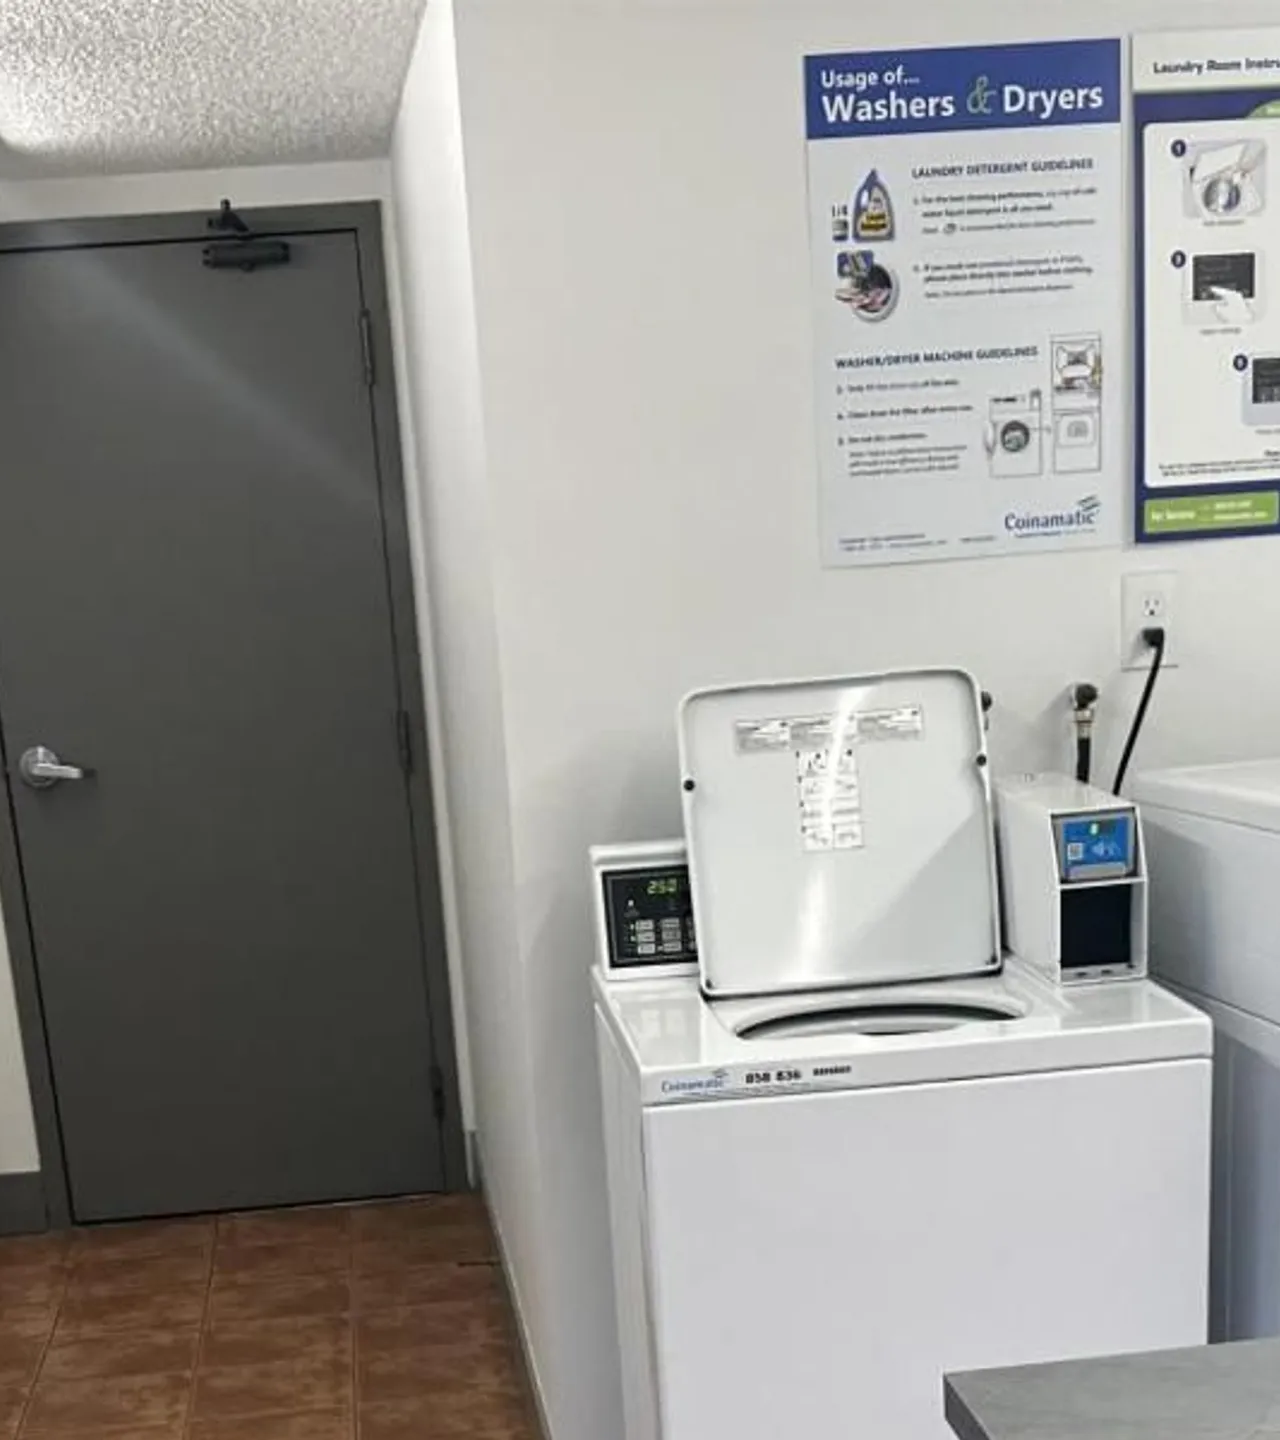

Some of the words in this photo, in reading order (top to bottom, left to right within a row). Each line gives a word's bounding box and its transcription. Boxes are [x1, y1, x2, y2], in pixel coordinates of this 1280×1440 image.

[1153, 60, 1203, 76] Laundry
[1207, 58, 1241, 72] Room
[821, 69, 878, 92] Usage
[822, 92, 955, 123] Washers
[966, 76, 997, 114] &
[1003, 85, 1103, 119] Dryers
[912, 165, 963, 179] LAUNDRY
[966, 162, 1028, 176] DETERGENT
[1031, 158, 1093, 172] GUIDELINES
[976, 346, 1039, 360] GUIDELINES
[1004, 510, 1095, 532] Coinamatic
